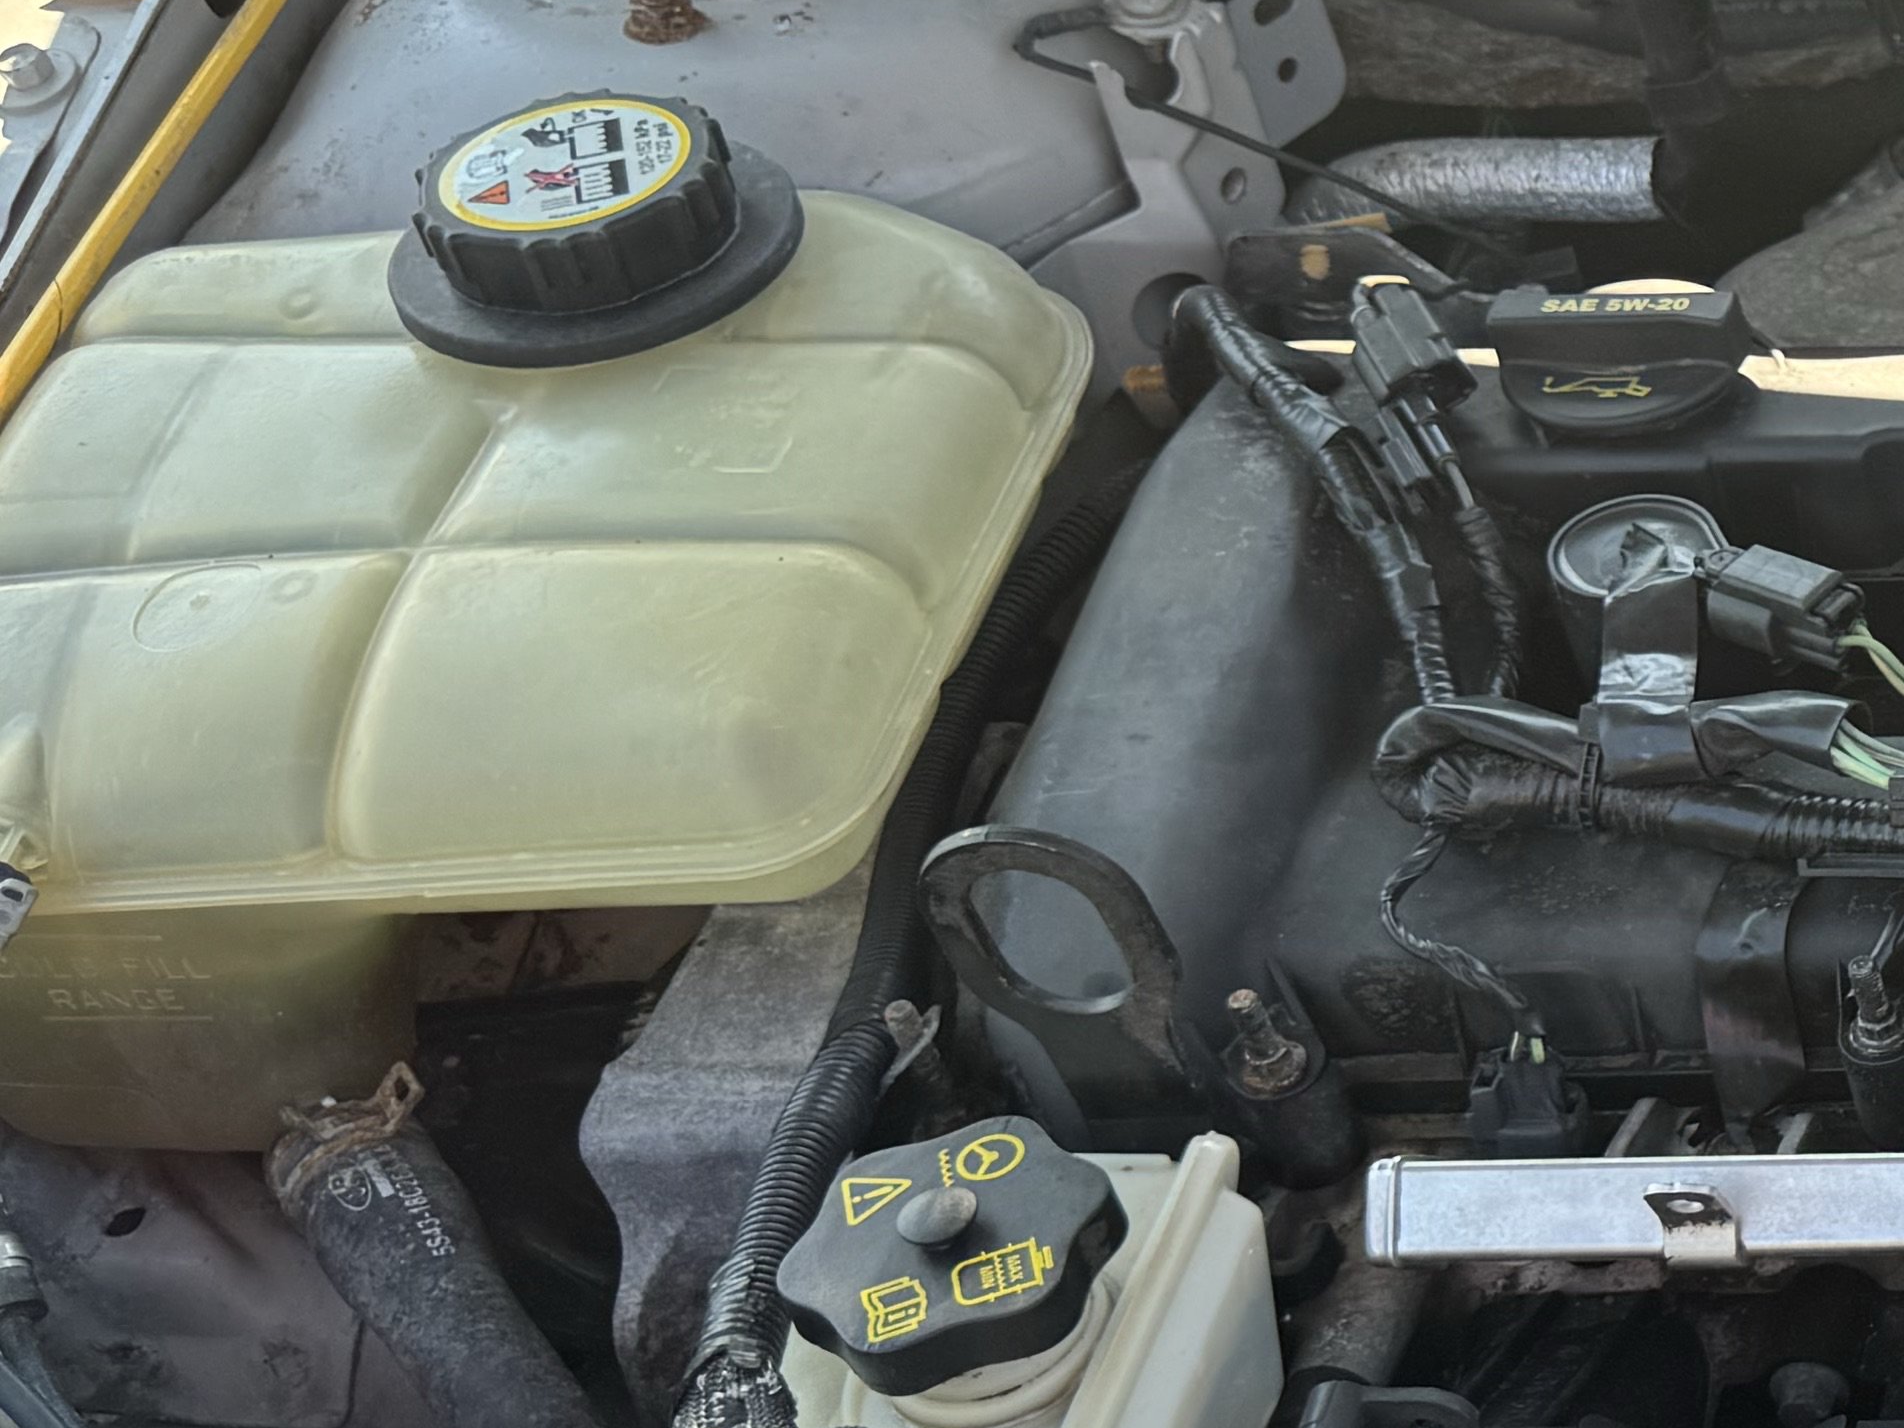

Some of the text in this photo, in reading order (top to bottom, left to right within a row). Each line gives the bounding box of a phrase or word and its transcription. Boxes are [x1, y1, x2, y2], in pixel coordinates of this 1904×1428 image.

[634, 119, 650, 139] kPa
[653, 122, 673, 164] 17-22 psi
[1541, 297, 1690, 313] SAE 5W-20
[122, 957, 212, 979] FILL
[47, 988, 185, 1010] RANGE
[979, 1265, 996, 1290] MIN
[1007, 1254, 1024, 1282] MAX
